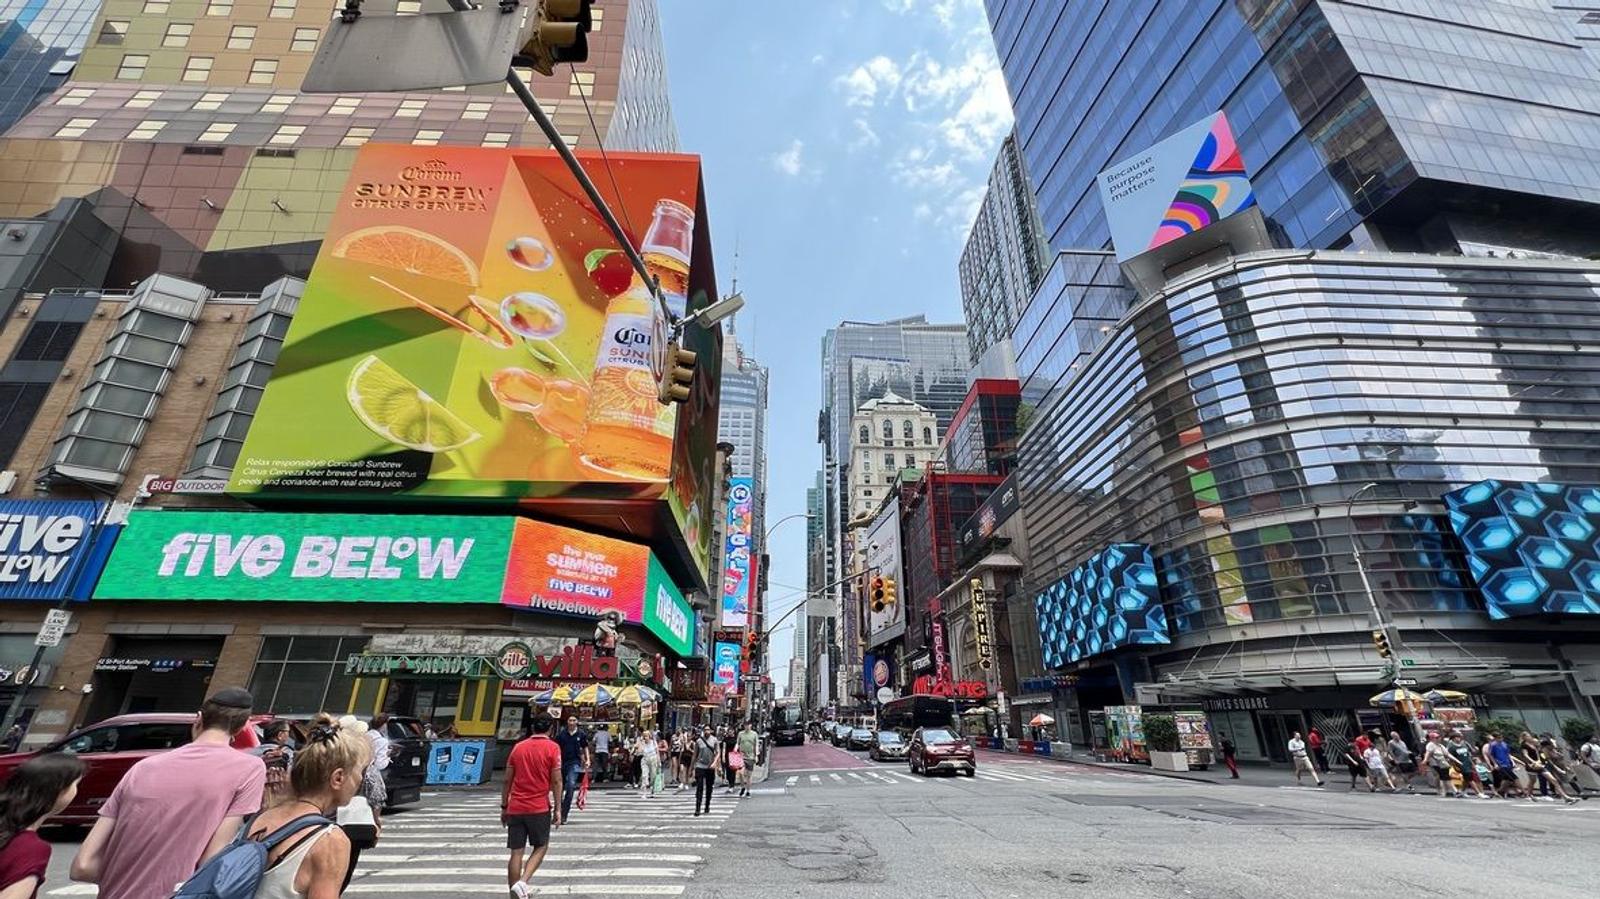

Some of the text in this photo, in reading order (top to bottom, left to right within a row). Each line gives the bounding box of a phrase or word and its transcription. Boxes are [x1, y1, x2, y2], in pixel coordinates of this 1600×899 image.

[399, 166, 461, 181] Corona
[1107, 156, 1152, 183] Because
[1109, 165, 1155, 195] purpose
[354, 183, 485, 200] SUNBREW
[1111, 177, 1156, 202] matters
[352, 199, 487, 212] CITRUS CERVEZA
[246, 458, 269, 466] Relax
[243, 467, 267, 476] Citrus
[269, 468, 303, 476] Cerveza
[305, 468, 325, 476] beer
[326, 469, 357, 477] brewed
[359, 470, 376, 478] with
[377, 470, 393, 478] real
[151, 480, 225, 490] BIG OUTDOOR
[264, 477, 280, 485] and
[157, 532, 285, 578] five
[549, 577, 574, 592] five
[976, 593, 990, 655] EMPIRE
[510, 680, 529, 688] PIZZA
[1233, 697, 1268, 710] SQUARE
